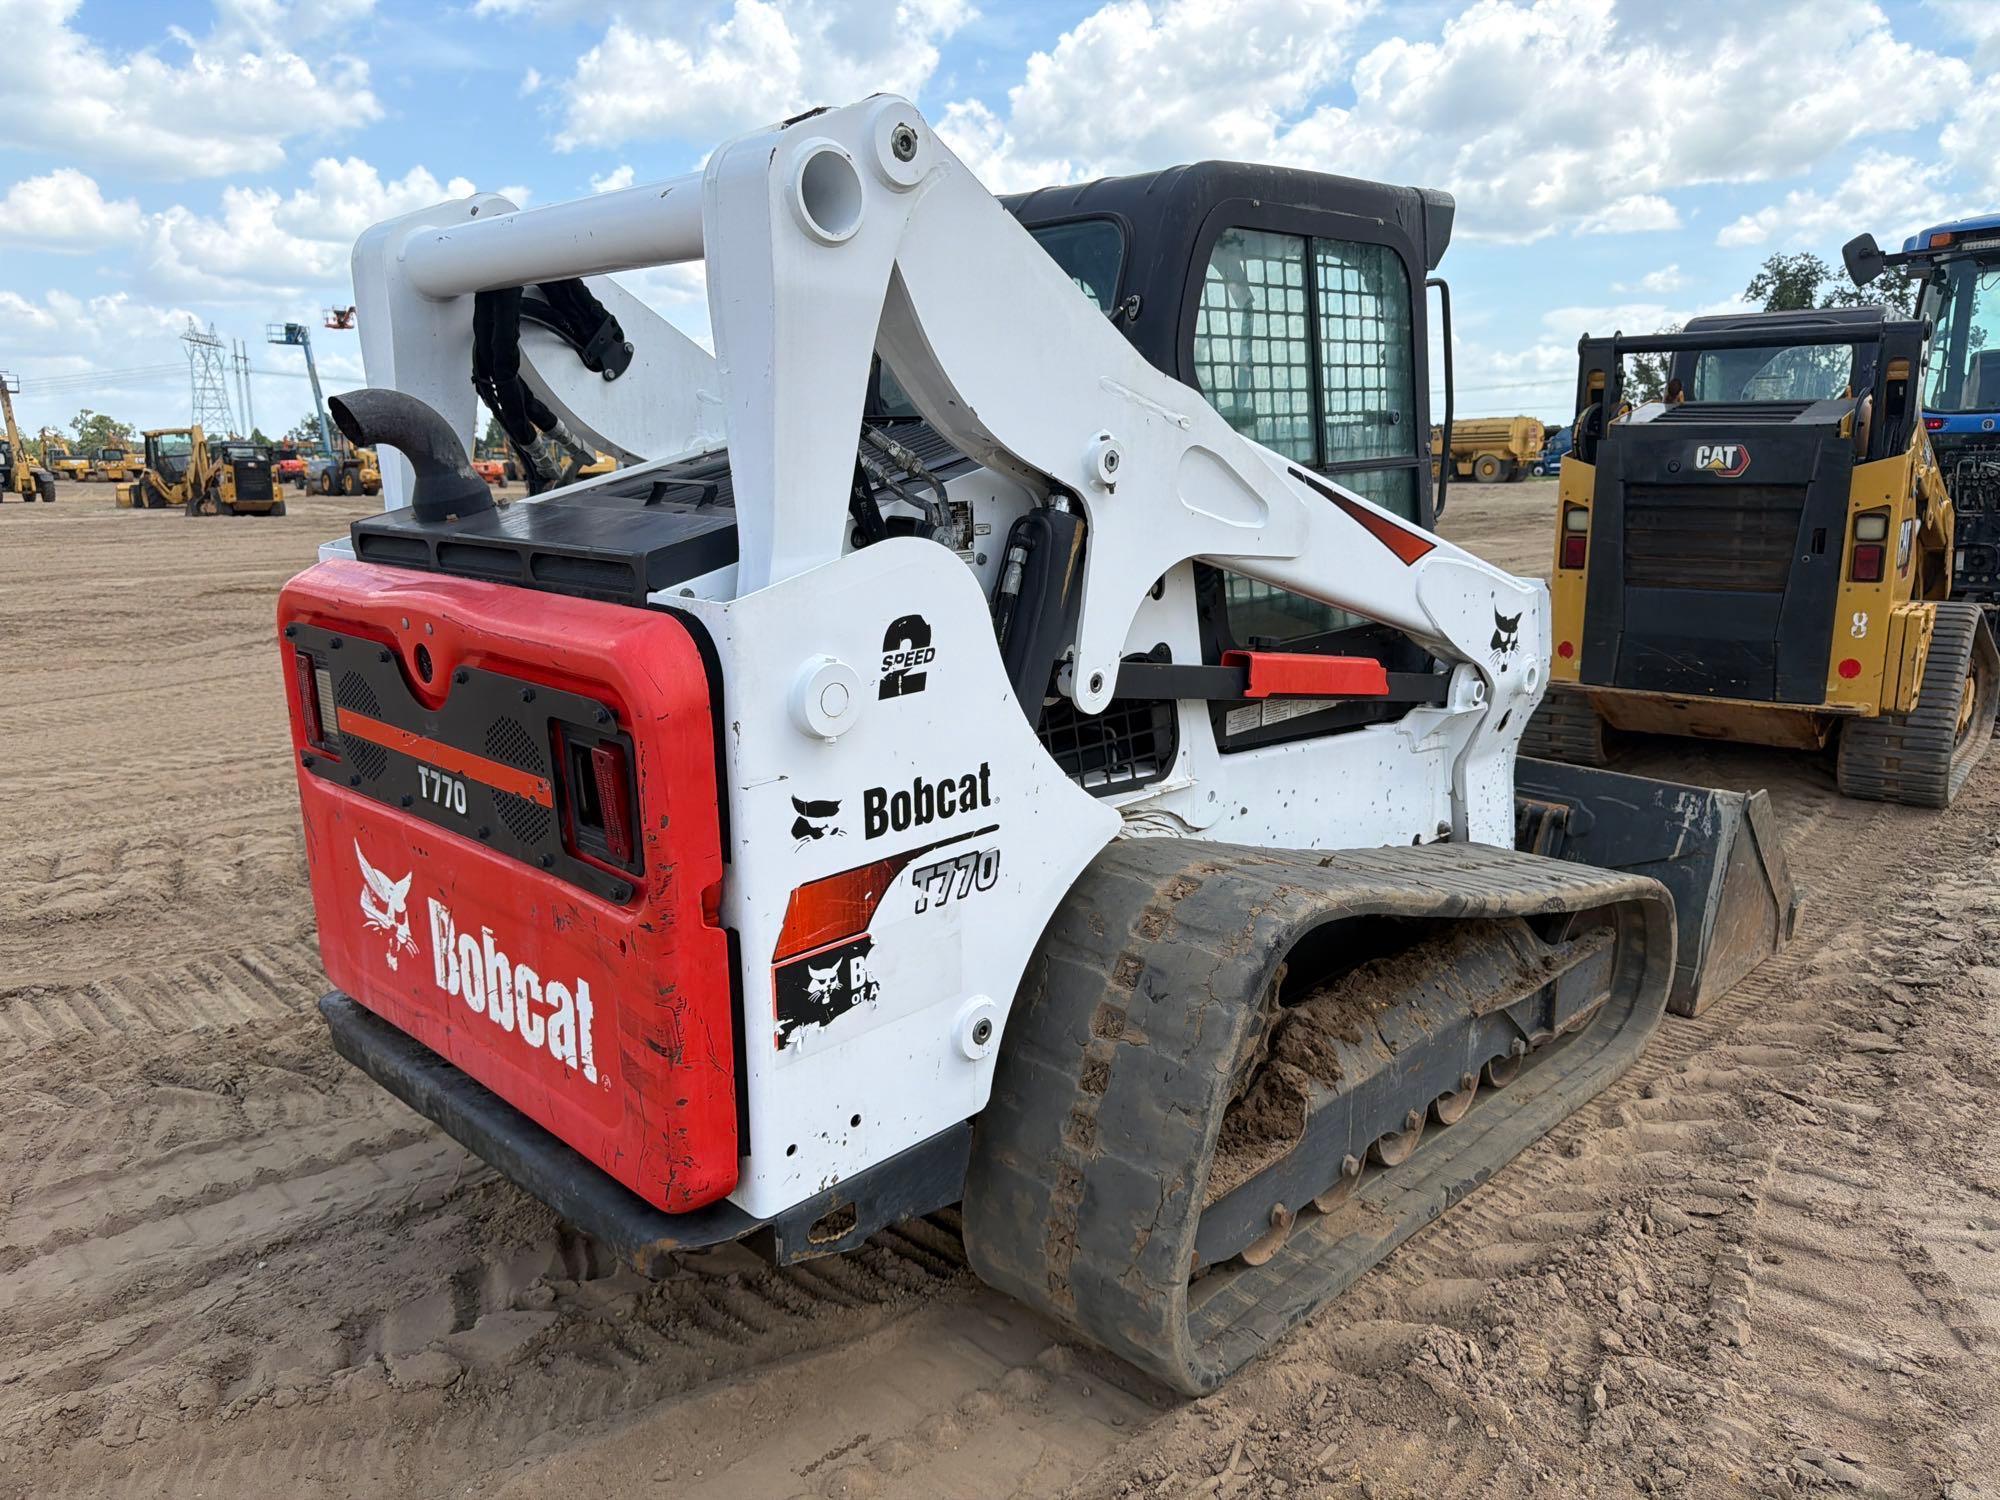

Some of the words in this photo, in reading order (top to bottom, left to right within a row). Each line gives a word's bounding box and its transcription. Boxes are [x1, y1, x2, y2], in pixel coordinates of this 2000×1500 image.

[1695, 445, 1737, 469] CAT
[1851, 612, 1868, 639] 8
[881, 647, 936, 672] SPEED
[417, 765, 467, 815] T770
[863, 762, 991, 840] Bobcat
[912, 847, 1001, 915] T770
[428, 896, 597, 1085] Bobcat
